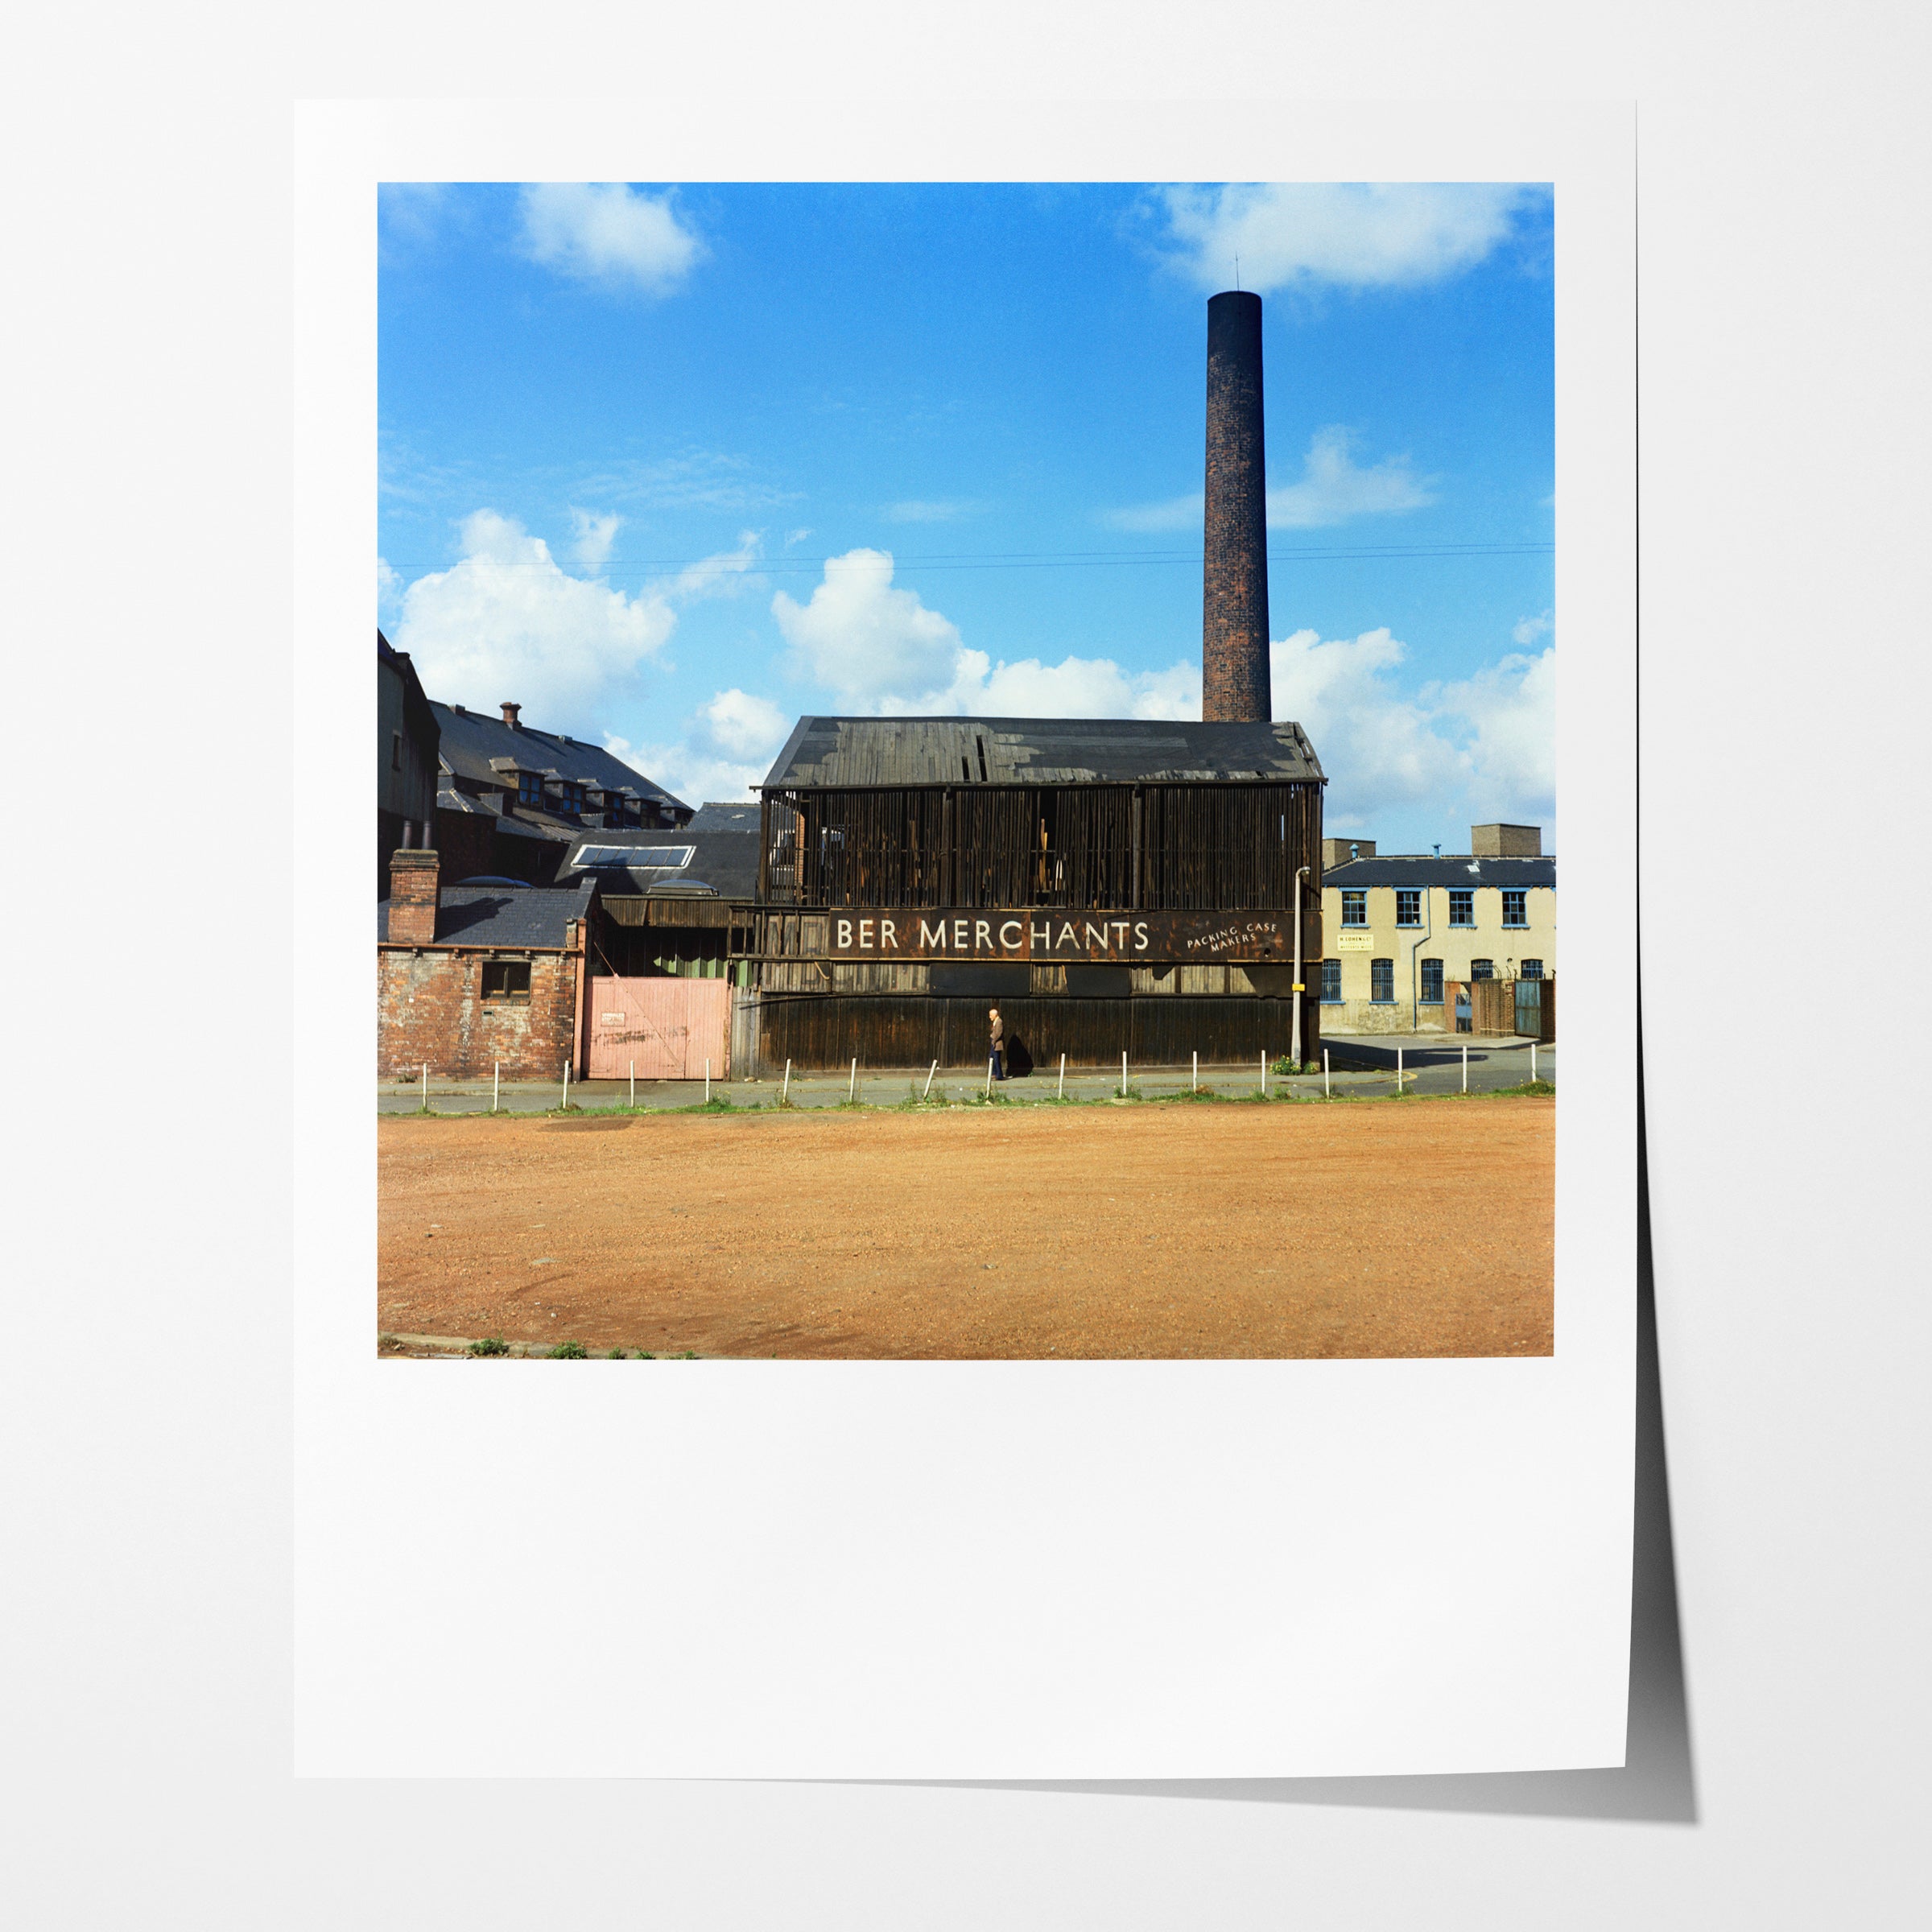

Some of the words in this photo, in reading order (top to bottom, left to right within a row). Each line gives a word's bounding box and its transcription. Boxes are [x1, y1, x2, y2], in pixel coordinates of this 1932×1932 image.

[837, 919, 898, 948] BER
[919, 919, 1149, 951] MERCHANTS
[1187, 927, 1237, 949] PACKING
[1246, 923, 1277, 933] CASE
[1211, 933, 1257, 952] MAKERS
